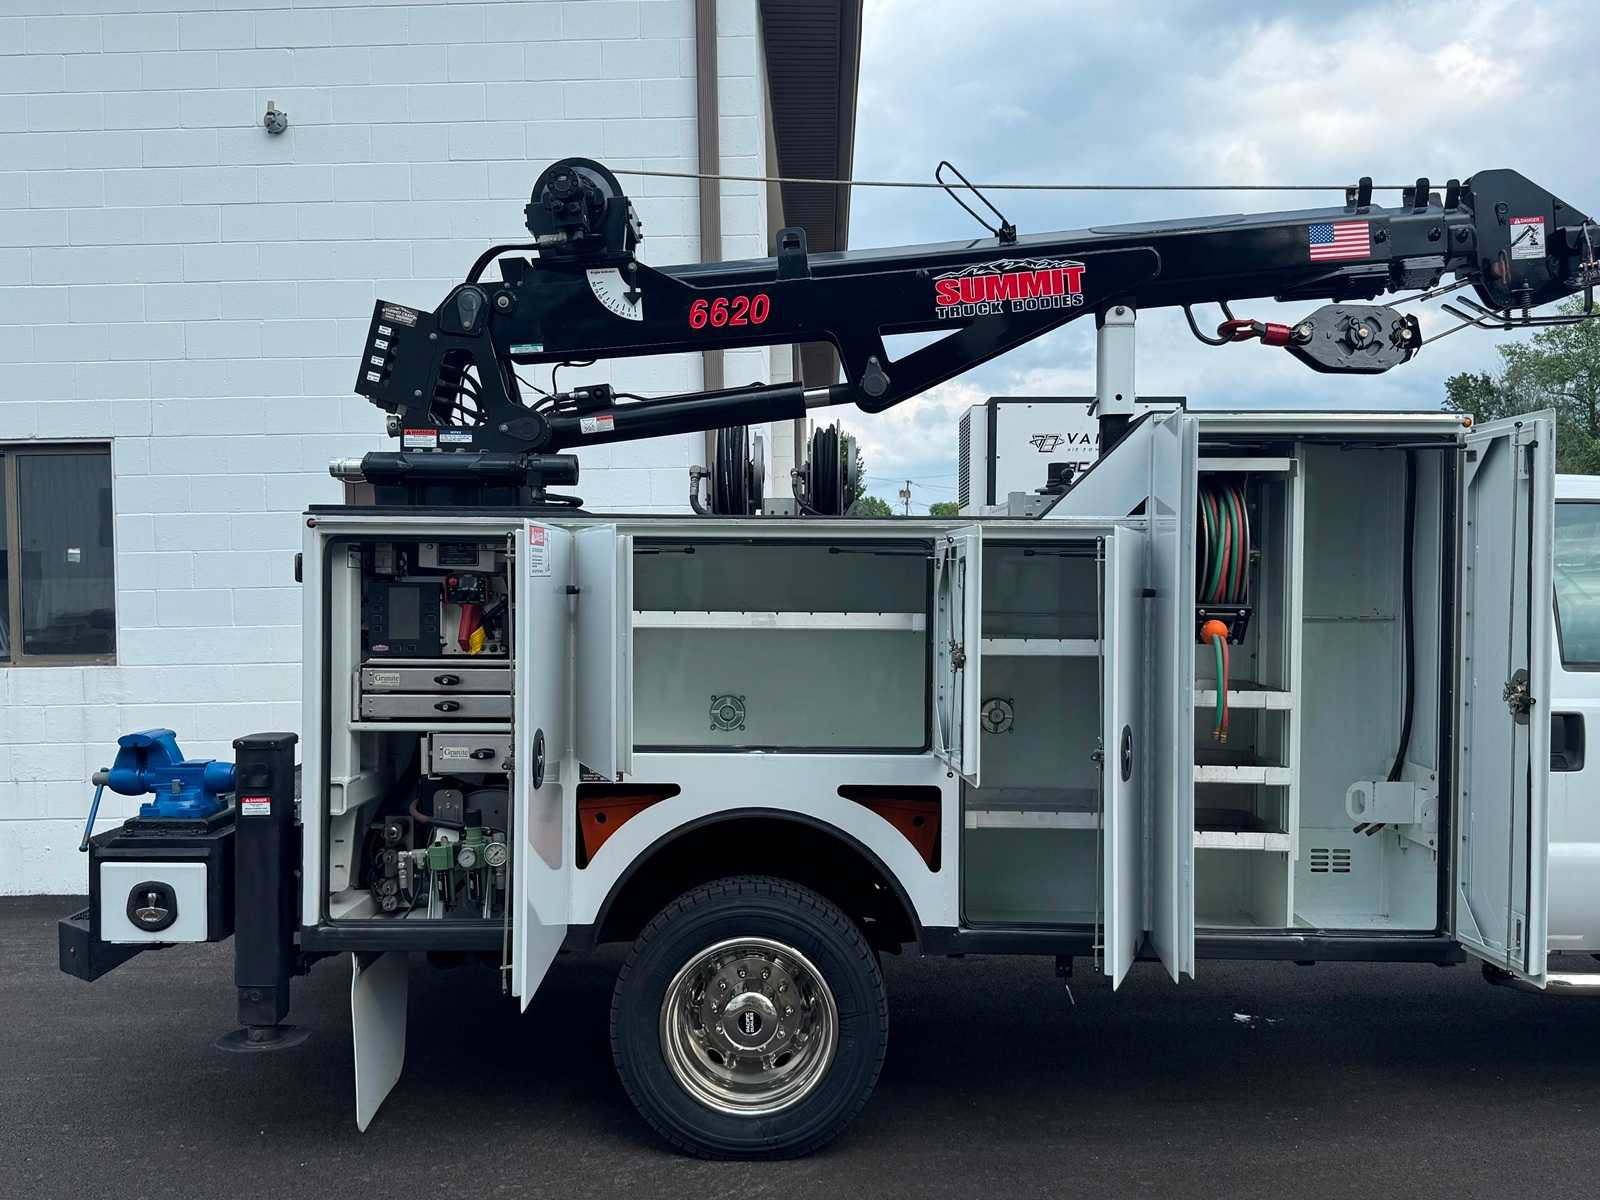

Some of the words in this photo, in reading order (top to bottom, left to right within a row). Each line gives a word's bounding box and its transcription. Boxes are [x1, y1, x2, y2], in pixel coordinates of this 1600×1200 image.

[935, 266, 1086, 305] SUMMIT
[689, 294, 770, 329] 6620
[936, 301, 1004, 319] TRUCK
[1012, 294, 1084, 313] BODIES
